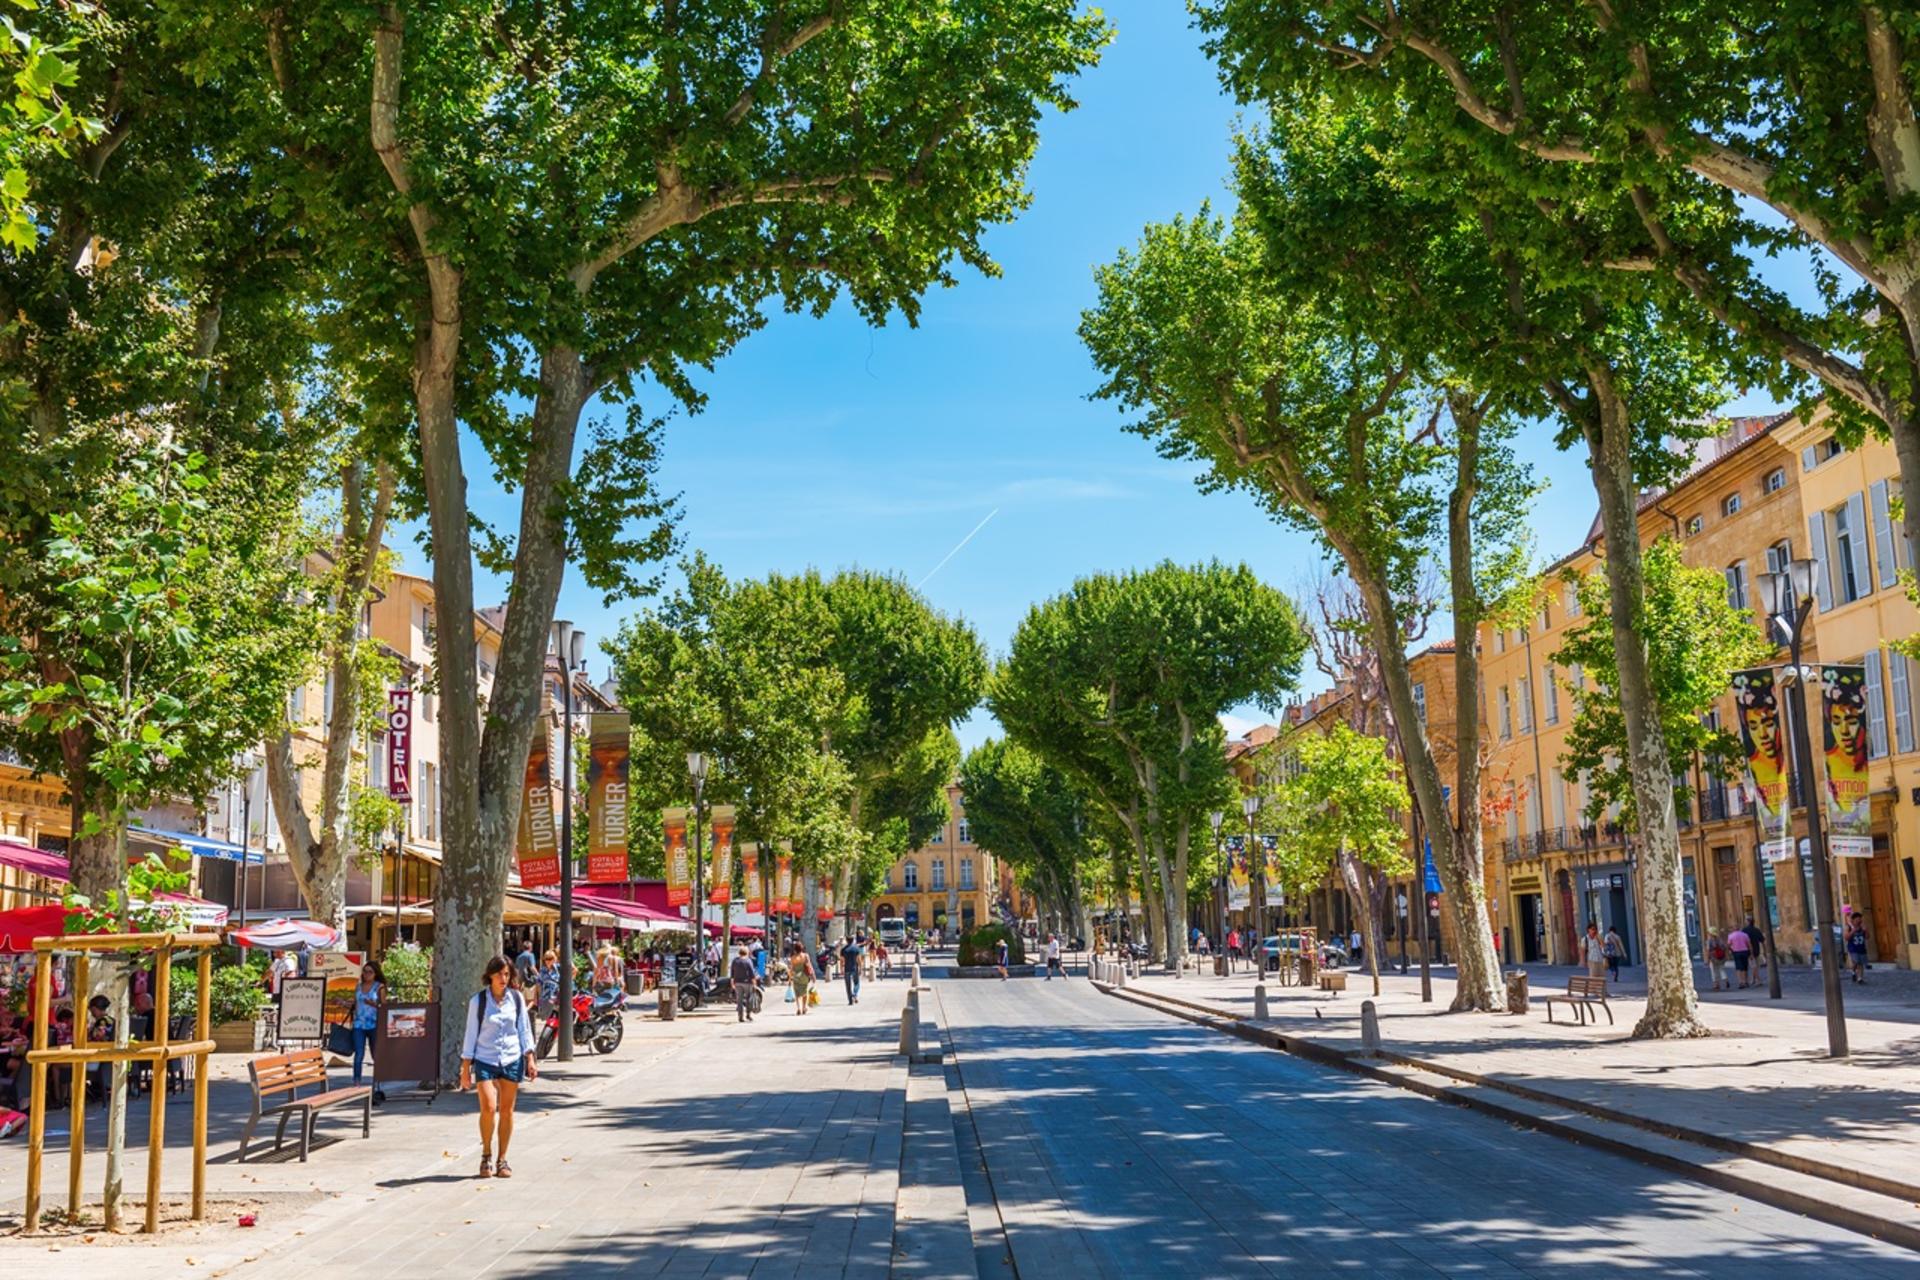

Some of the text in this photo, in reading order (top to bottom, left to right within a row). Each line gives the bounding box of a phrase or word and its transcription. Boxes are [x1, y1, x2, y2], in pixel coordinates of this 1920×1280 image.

[391, 695, 409, 782] HOTEL
[528, 785, 555, 852] TURNER
[604, 782, 626, 848] TURNER
[673, 846, 689, 886] TURNER
